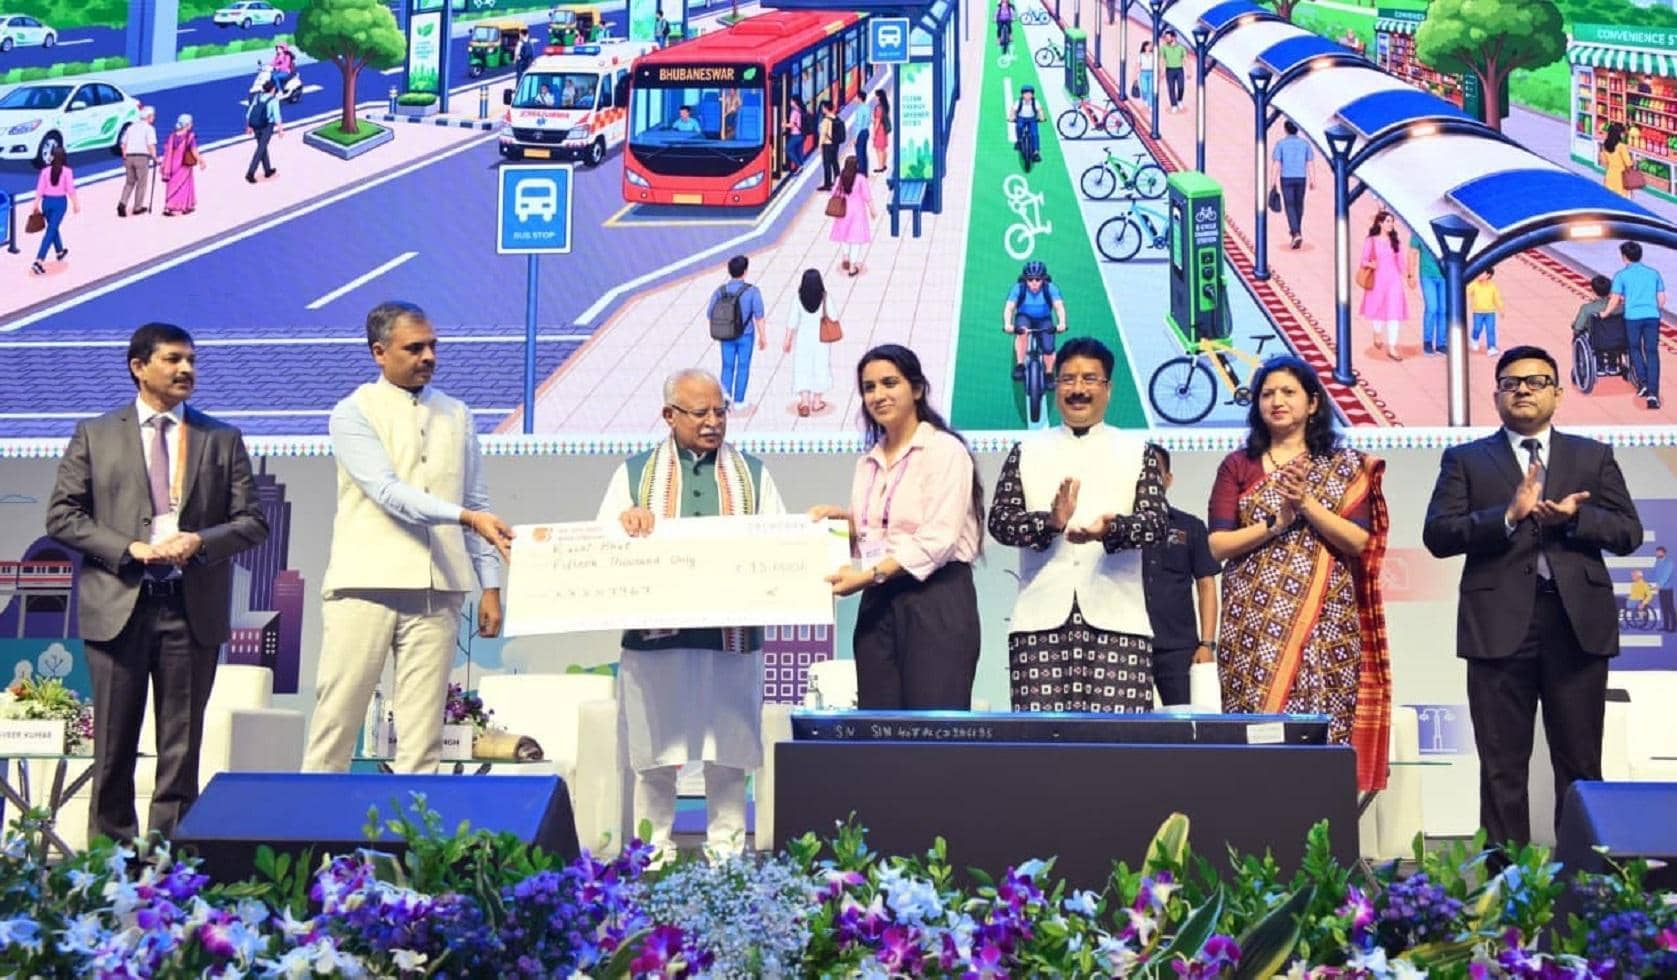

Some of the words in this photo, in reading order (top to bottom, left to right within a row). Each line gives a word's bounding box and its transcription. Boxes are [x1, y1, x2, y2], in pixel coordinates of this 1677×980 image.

[1597, 28, 1664, 44] CONVENIENCE
[659, 67, 734, 81] BHUBANESWAR
[512, 231, 531, 240] BUS
[533, 230, 556, 240] STOP
